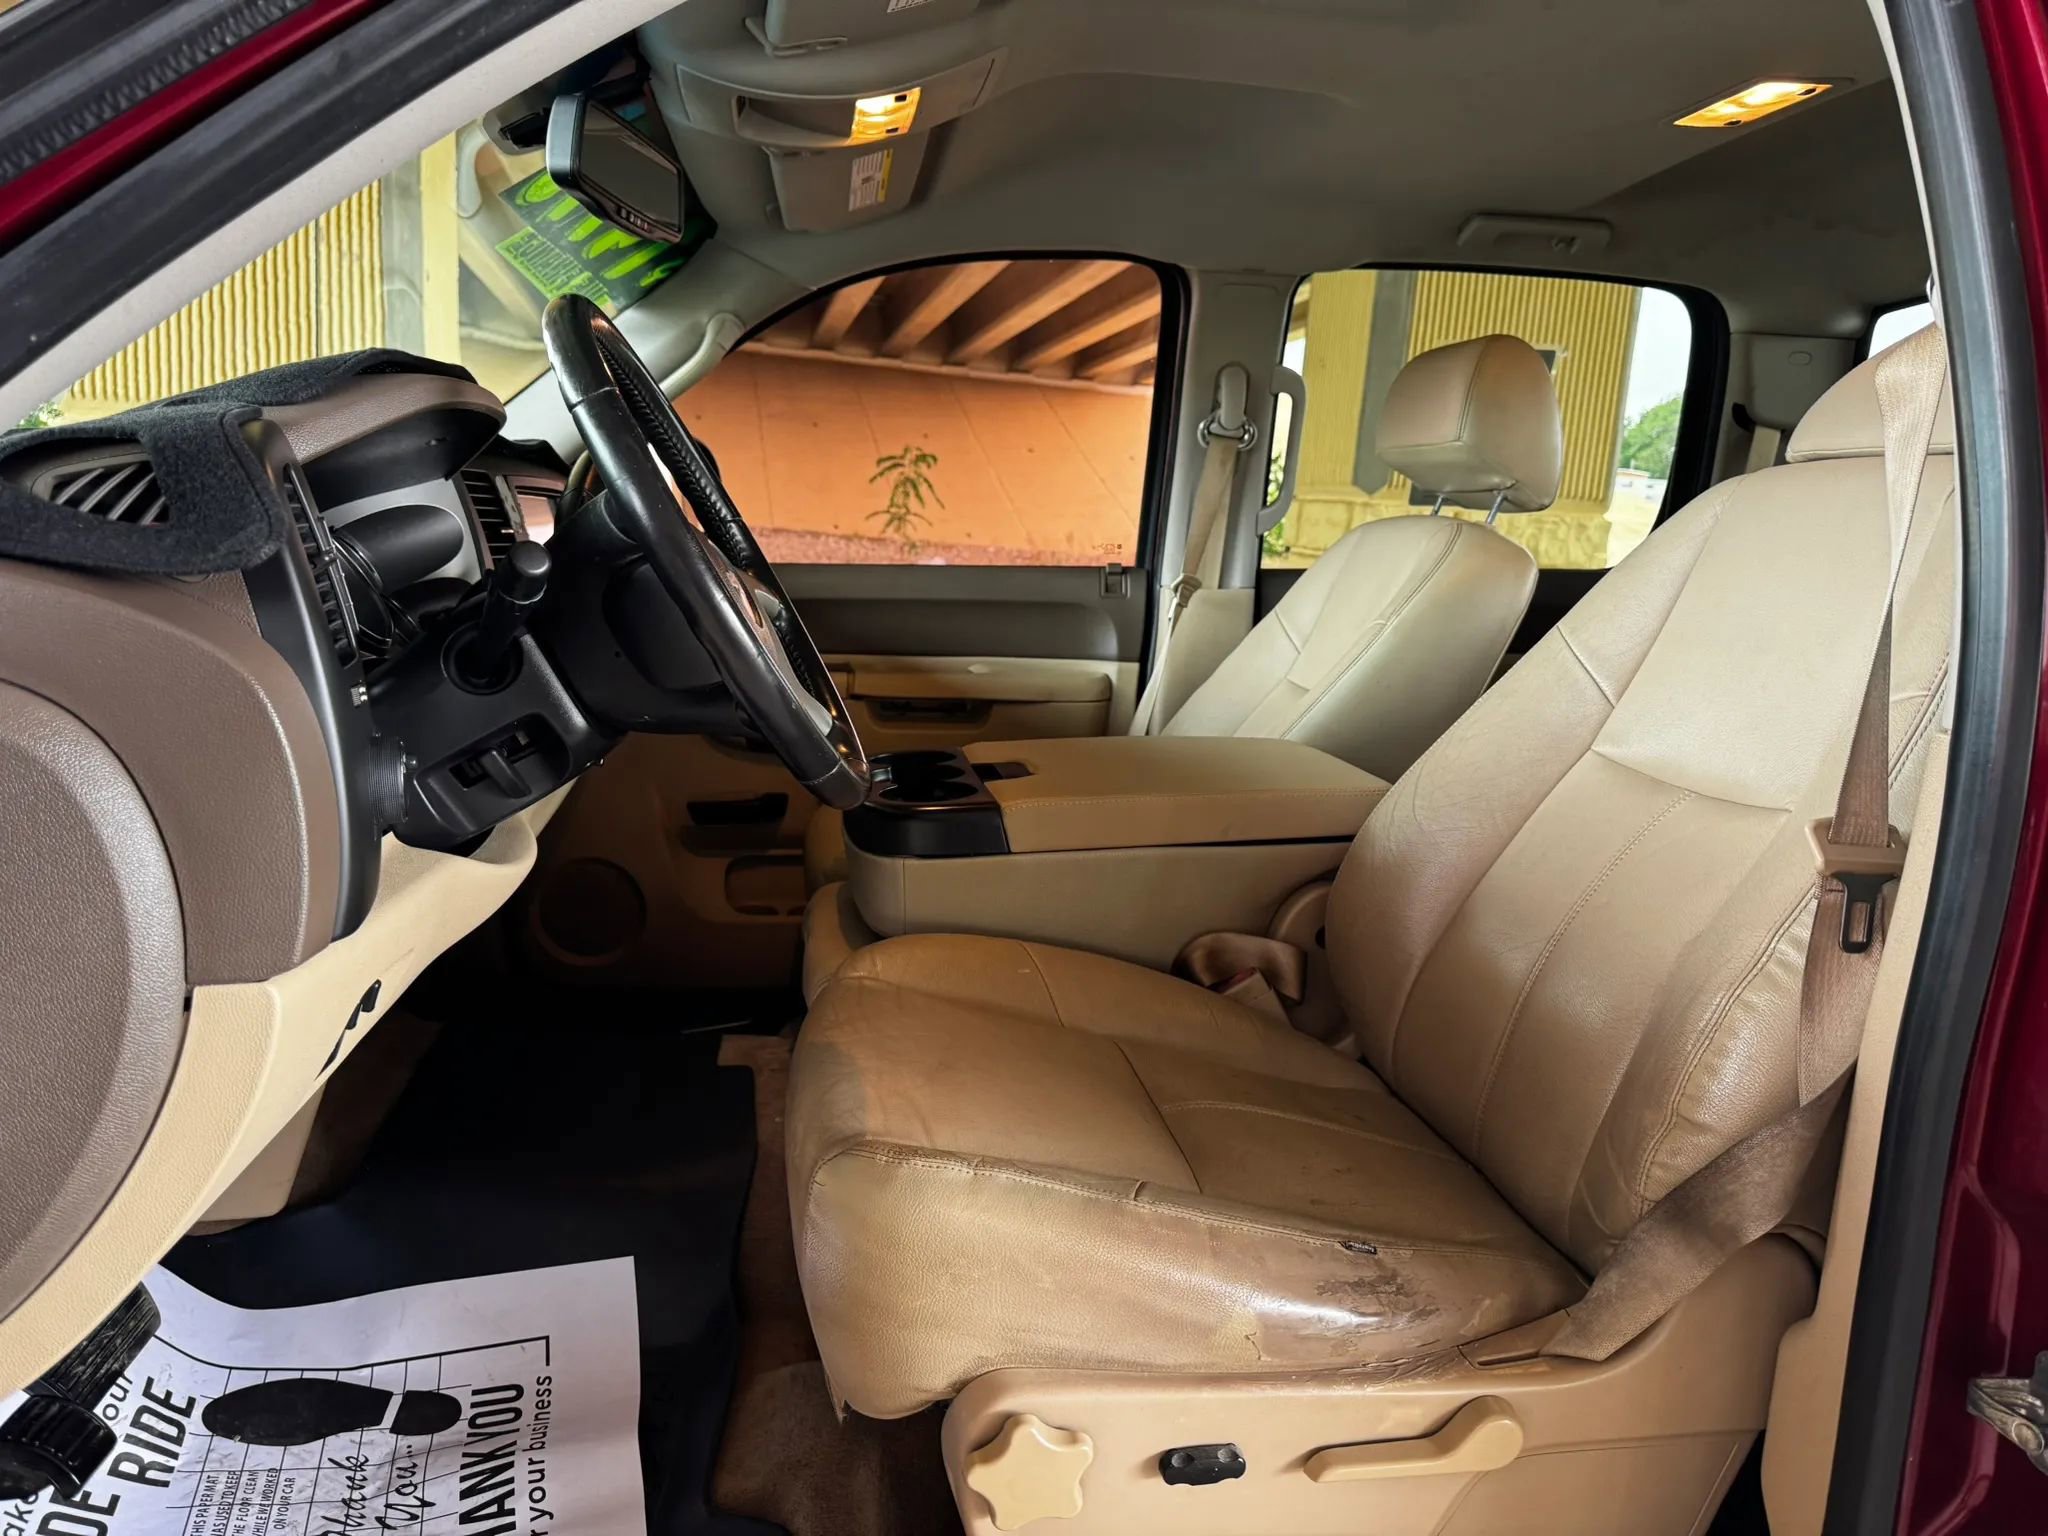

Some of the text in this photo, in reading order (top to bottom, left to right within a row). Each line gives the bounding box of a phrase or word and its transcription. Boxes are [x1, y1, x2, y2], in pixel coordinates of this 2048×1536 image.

[102, 1373, 133, 1421] our
[521, 1375, 552, 1452] business
[107, 1375, 197, 1488] RIDE
[458, 1383, 525, 1536] ANK YOU
[203, 1474, 219, 1494] MAT
[224, 1470, 240, 1490] KEEP
[243, 1471, 260, 1495] CLEAN
[260, 1467, 279, 1502] WORKED
[312, 1453, 369, 1536] hank
[528, 1457, 554, 1522] your
[195, 1493, 214, 1518] PAPER
[215, 1501, 231, 1520] USED
[221, 1490, 235, 1501] TO
[236, 1496, 253, 1522] FLOOR
[258, 1502, 270, 1515] WE
[272, 1476, 296, 1530] ON YOUR CAR
